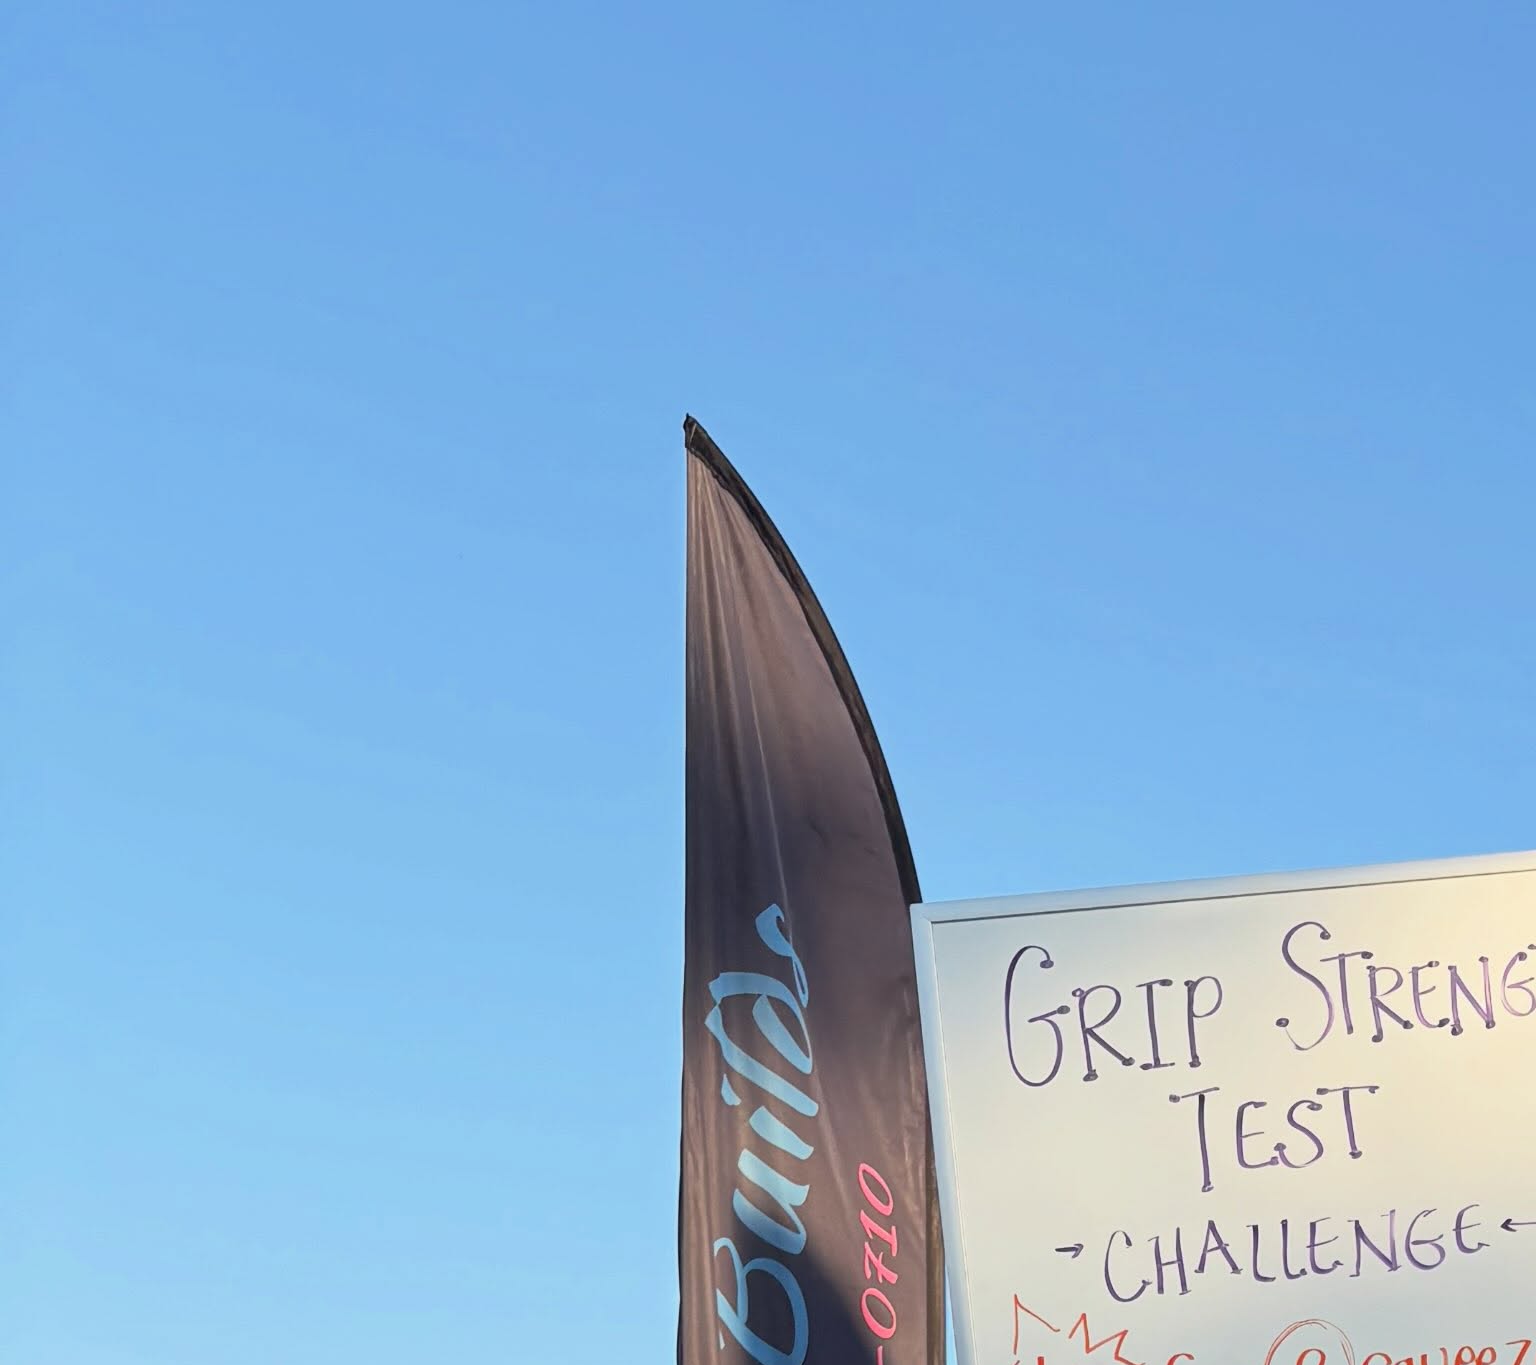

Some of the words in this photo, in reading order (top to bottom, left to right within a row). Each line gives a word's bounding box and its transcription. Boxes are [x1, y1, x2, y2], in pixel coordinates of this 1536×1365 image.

[1004, 945, 1223, 1088] GRIP
[1168, 1085, 1380, 1193] TEST
[1104, 1203, 1490, 1303] CHALLENGE
